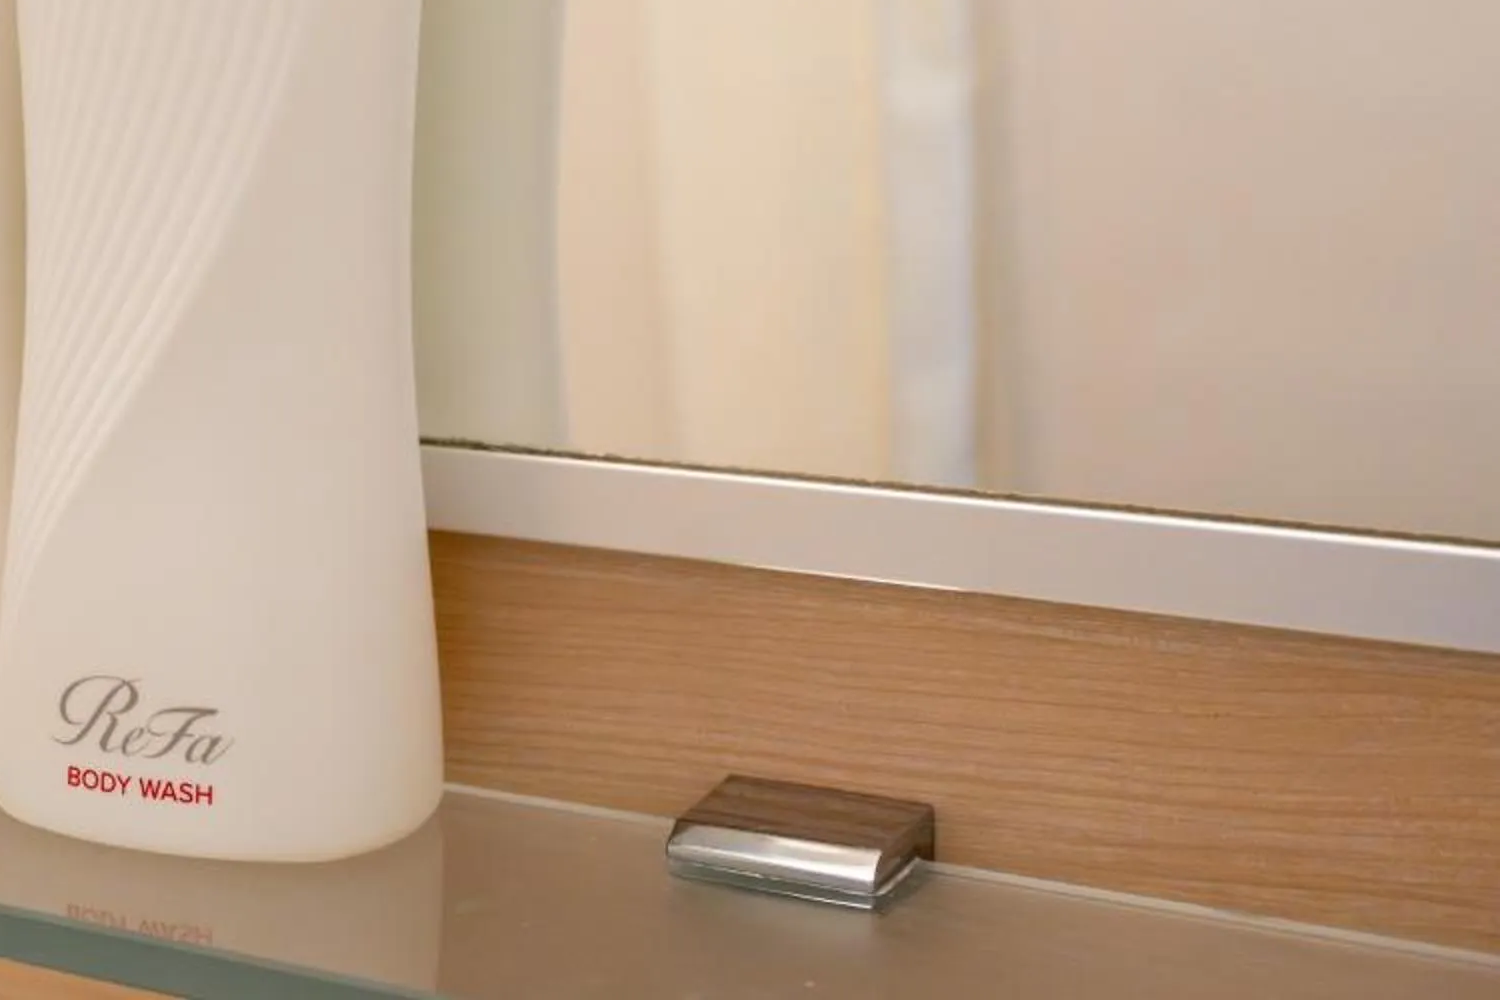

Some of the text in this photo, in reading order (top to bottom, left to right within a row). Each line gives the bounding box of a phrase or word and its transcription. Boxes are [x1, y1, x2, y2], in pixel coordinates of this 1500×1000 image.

[52, 675, 234, 765] ReFa
[67, 766, 214, 805] BODY WASH
